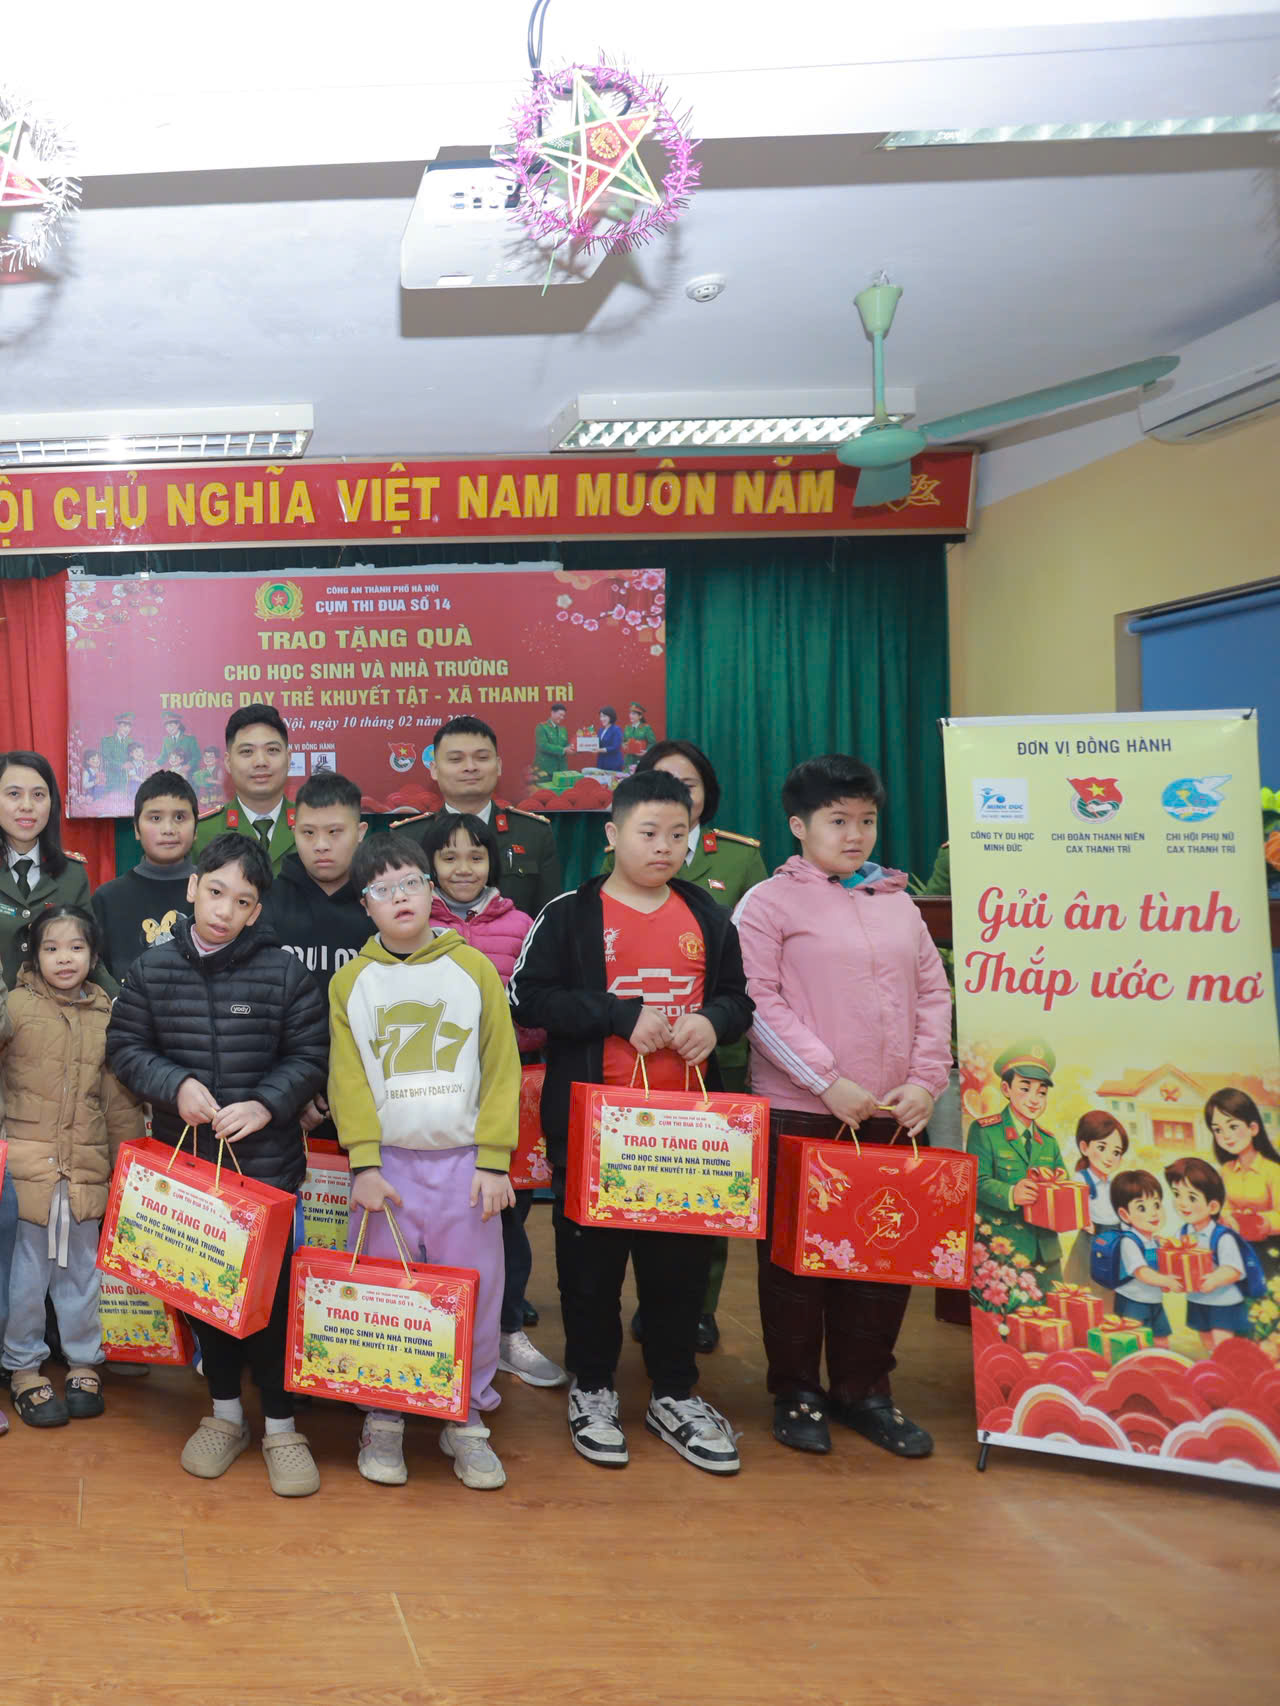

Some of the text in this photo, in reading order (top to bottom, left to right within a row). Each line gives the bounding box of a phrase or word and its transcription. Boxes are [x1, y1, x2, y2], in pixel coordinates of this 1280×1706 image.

[53, 470, 148, 532] CHỦ
[167, 465, 316, 527] NGHĨA
[337, 462, 441, 534] VIỆT
[458, 473, 559, 519] NAM
[575, 458, 717, 517] MUÔN
[731, 456, 836, 514] NĂM
[326, 586, 349, 595] CÔNG
[364, 585, 391, 594] THÀNH
[393, 584, 409, 593] PHỐ
[411, 584, 423, 593] HÀ
[424, 584, 439, 594] NỘI
[315, 595, 451, 615] CỤM THI ĐUA SỐ 14
[258, 624, 472, 652] TRAO TẶNG QUÀ
[224, 656, 509, 684] CHO HỌC SINH VÀ NHÀ TRƯỜNG
[160, 688, 233, 709] TRƯỜNG
[281, 685, 314, 707] TRẺ
[320, 684, 390, 706] KHUYẾT
[396, 685, 429, 708] TẬT
[448, 685, 472, 704] XÃ
[478, 686, 539, 703] THANH
[545, 682, 574, 702] TRÌ
[310, 718, 339, 731] ngày
[343, 717, 357, 728] 10
[360, 716, 394, 730] tháng
[398, 716, 412, 727] 02
[415, 715, 442, 727] năm
[1017, 736, 1171, 758] ĐƠN VỊ ĐỒNG HÀNH
[970, 830, 1035, 842] CÔNG TY DU HỌC
[1051, 831, 1145, 841] CHI ĐOÀN THANH NIÊN
[1166, 832, 1181, 841] CHI
[983, 843, 1005, 852] MINH
[1066, 844, 1131, 854] CAX THANH TRÌ
[1167, 845, 1185, 854] CAX
[1188, 845, 1219, 854] THANH
[977, 886, 1240, 943] Gửi ân tình
[605, 954, 617, 962] IFA
[964, 946, 1265, 1012] Thắp ước mơ
[390, 1088, 408, 1100] BEAT
[623, 1135, 657, 1148] TRAO
[661, 1136, 697, 1151] TẶNG
[621, 1153, 653, 1163] CHO HỌC
[141, 1194, 168, 1217] TRAO
[170, 1207, 201, 1231] TẶNG
[326, 1306, 359, 1322] TRAO
[363, 1311, 400, 1328] TẶNG
[323, 1325, 338, 1334] CHO
[340, 1327, 355, 1337] HỌC
[356, 1328, 374, 1338] SINH
[375, 1330, 385, 1340] VÀ
